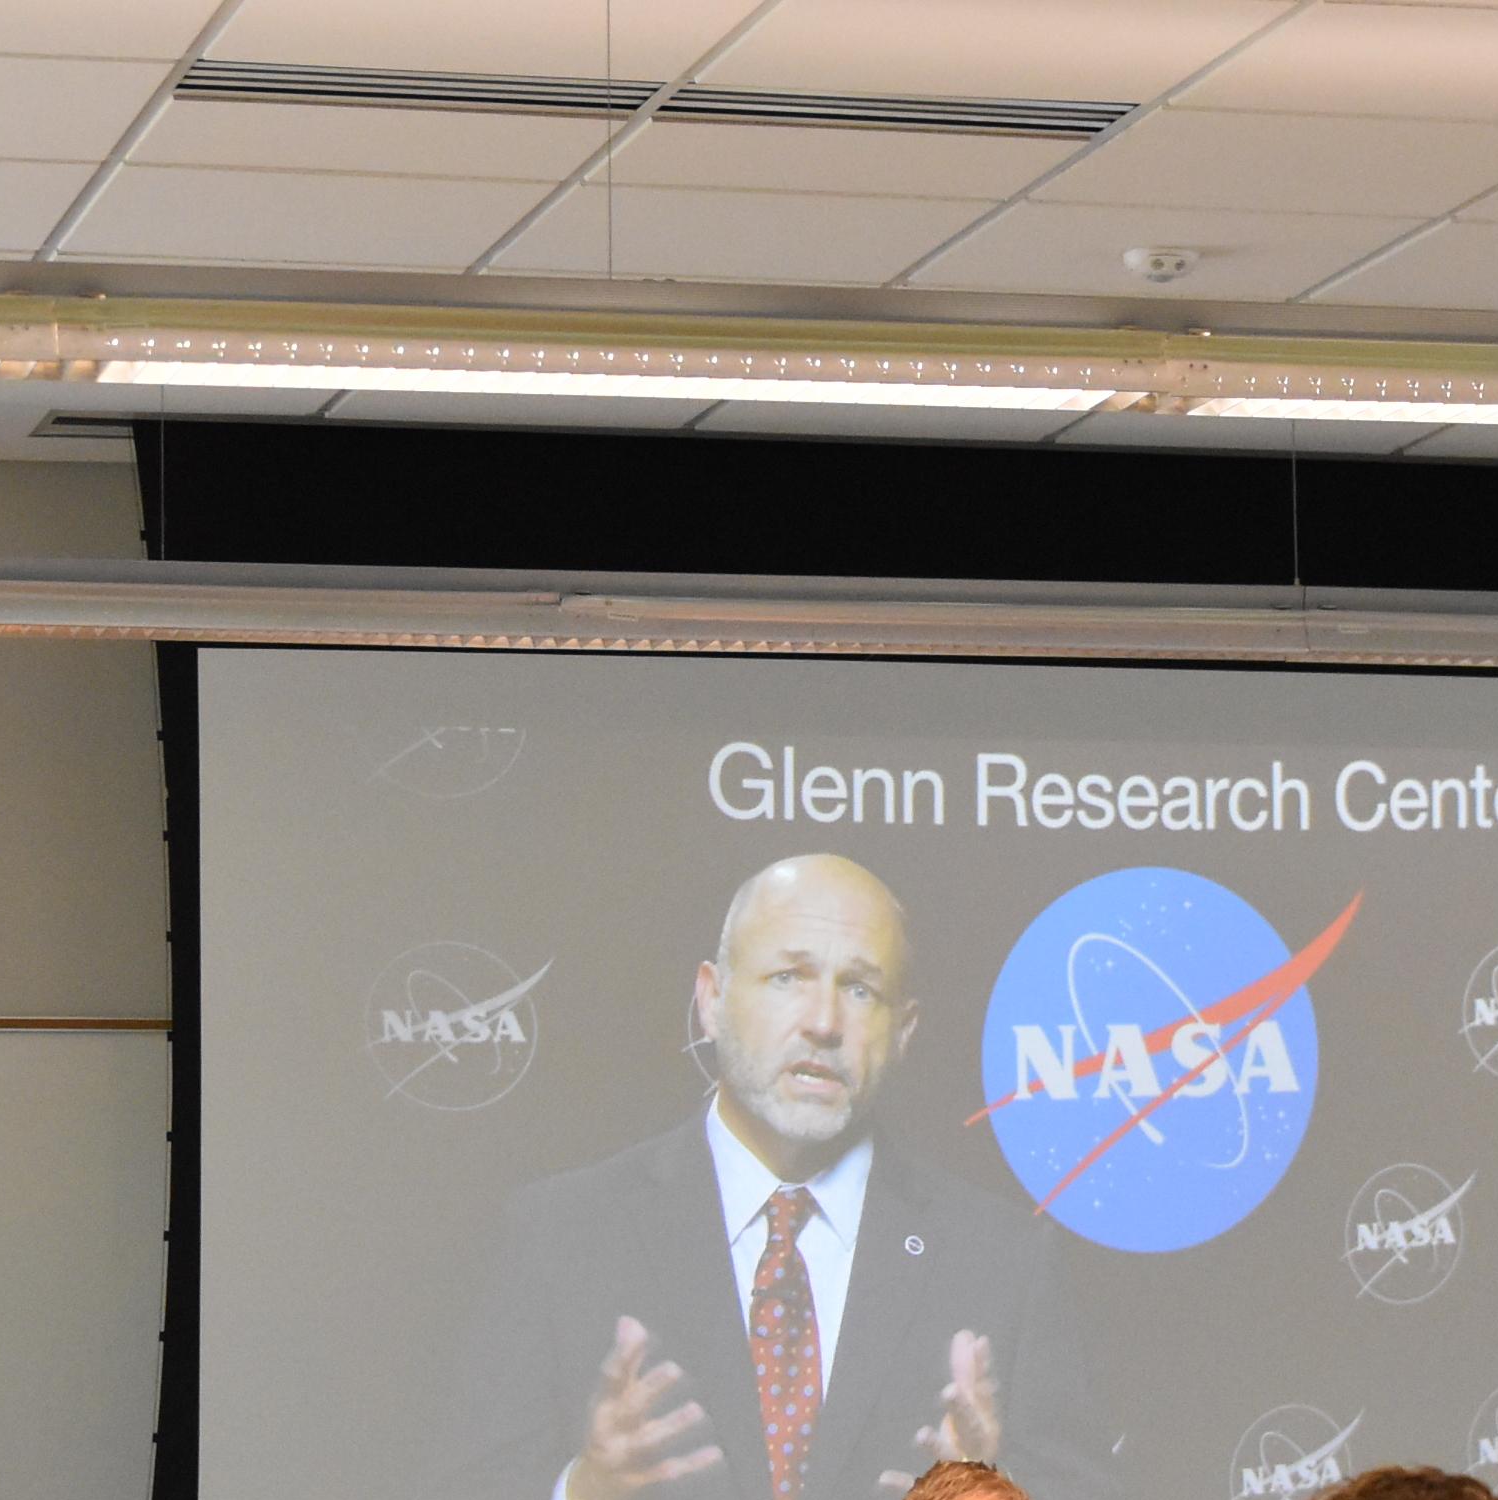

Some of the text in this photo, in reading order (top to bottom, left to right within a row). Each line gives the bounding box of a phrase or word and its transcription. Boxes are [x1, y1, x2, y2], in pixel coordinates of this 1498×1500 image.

[708, 741, 945, 825] Glenn
[976, 752, 1310, 832] Research
[382, 1009, 527, 1043] NASA
[1011, 1019, 1300, 1100] NASA
[1356, 1216, 1456, 1251] NASA
[1241, 1457, 1342, 1497] NASA
